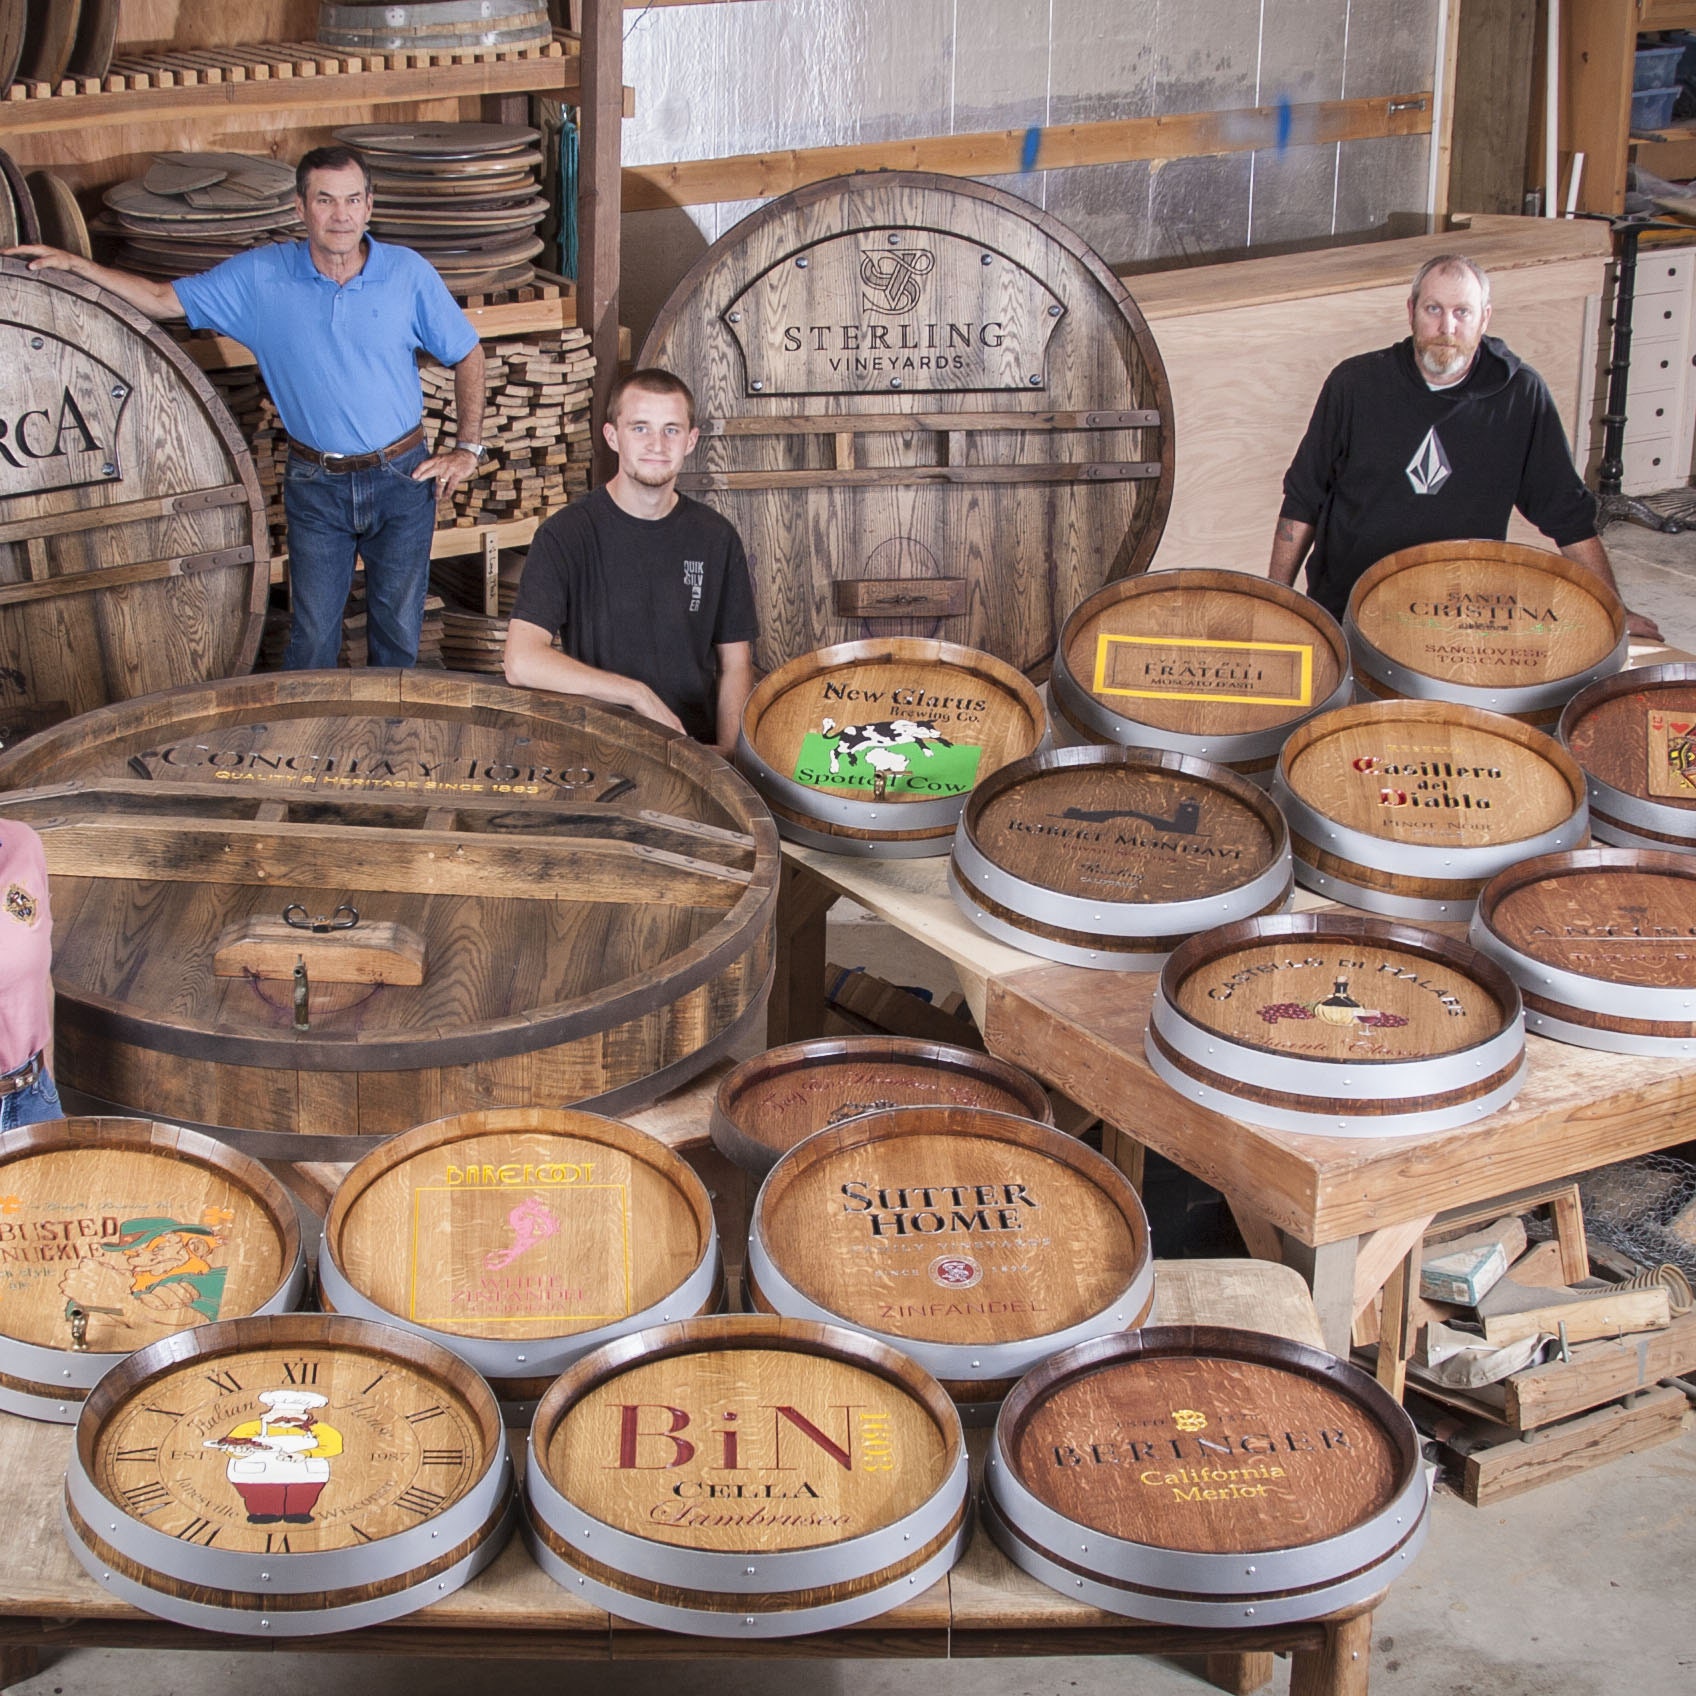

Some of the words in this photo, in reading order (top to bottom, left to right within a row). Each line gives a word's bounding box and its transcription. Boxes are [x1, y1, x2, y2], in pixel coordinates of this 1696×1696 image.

[784, 322, 1004, 351] STERLING
[829, 355, 963, 371] VINEYARDS
[1448, 592, 1518, 605] SANTA
[1409, 602, 1559, 622] CRISTINA
[1424, 644, 1548, 659] SANGIOVESE
[1144, 662, 1263, 681] FRATELLI
[823, 681, 885, 704] New
[891, 688, 986, 712] Glarus
[889, 706, 950, 723] Brewing
[957, 711, 980, 723] Co.
[454, 758, 597, 789] TORO
[1352, 756, 1502, 779] Casillero
[214, 770, 297, 783] QUALITY
[301, 774, 317, 784] &
[323, 776, 419, 788] HERITAGE
[424, 780, 484, 793] SINCE
[492, 784, 540, 794] 1883
[906, 776, 967, 793] Cow
[1417, 780, 1448, 791] del
[1377, 788, 1490, 809] Diablo
[1009, 819, 1104, 843] ROBERT
[1208, 957, 1324, 1000] CASTELLO
[1338, 959, 1365, 969] DI
[446, 1163, 595, 1184] BAREFOOT
[840, 1181, 1040, 1213] SUTTER
[0, 1217, 119, 1241] BUSTED
[870, 1208, 1023, 1237] HOME
[879, 1301, 1048, 1318] ZINFANDEL
[207, 1371, 243, 1396] XI
[281, 1361, 321, 1385] XII
[362, 1368, 390, 1394] I
[404, 1405, 447, 1424] II
[601, 1404, 867, 1471] BiN
[860, 1412, 893, 1473] 1603
[1052, 1430, 1351, 1467] BERINGER
[369, 1452, 411, 1462] 1987
[422, 1449, 464, 1466] III
[1140, 1464, 1287, 1486] California
[672, 1480, 824, 1499] CELLA
[1173, 1482, 1270, 1503] Merlot
[646, 1500, 851, 1528] Lambrusco
